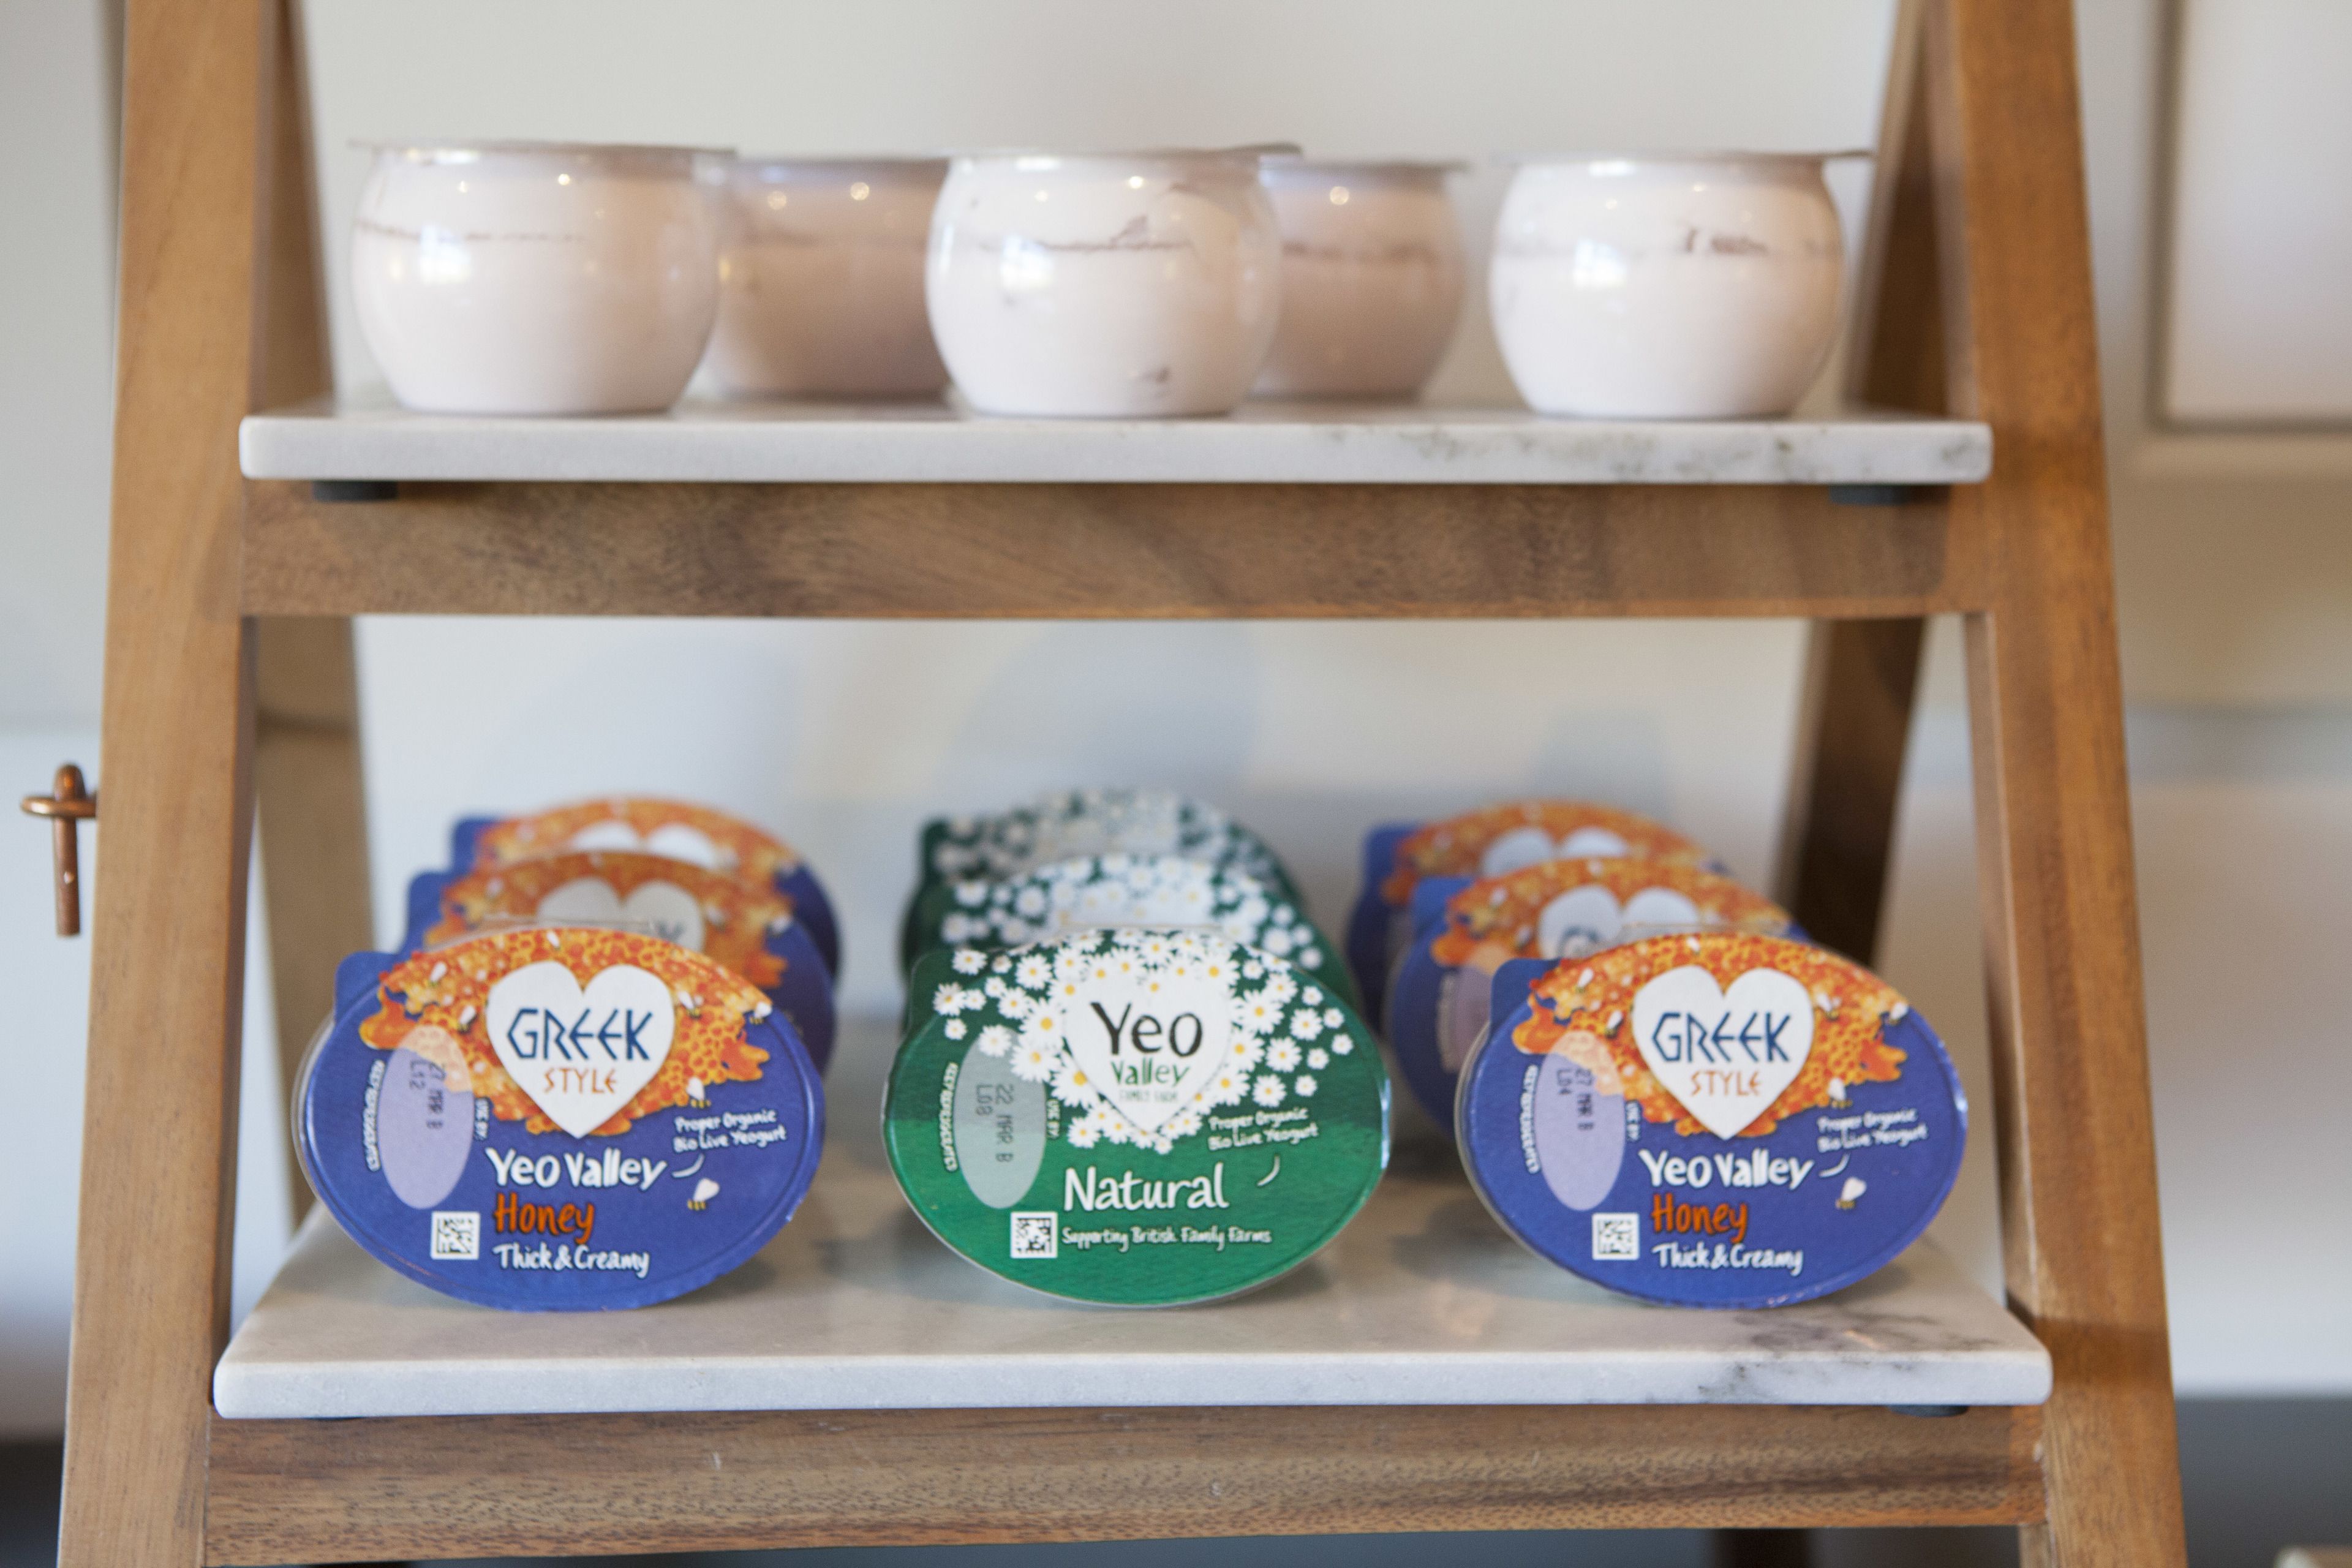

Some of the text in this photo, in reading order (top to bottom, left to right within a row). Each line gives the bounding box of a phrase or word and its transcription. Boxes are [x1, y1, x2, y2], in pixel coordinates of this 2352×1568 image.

[507, 1008, 653, 1060] GREEK
[1090, 1001, 1203, 1057] Yeo
[1652, 1012, 1791, 1063] GREEK
[544, 1068, 617, 1094] STYLE
[1110, 1057, 1190, 1088] Valley
[1691, 1071, 1760, 1096] STYLE
[675, 1109, 776, 1138] Proper Organic
[1256, 1107, 1308, 1128] Organic
[484, 1147, 668, 1191] Yeo Valley
[1064, 1162, 1229, 1212] Natural
[1638, 1148, 1815, 1190] Yeo Valley
[493, 1191, 594, 1245] Honey
[1061, 1225, 1272, 1253] Supporting British Family Farms
[1651, 1192, 1747, 1244] Honey
